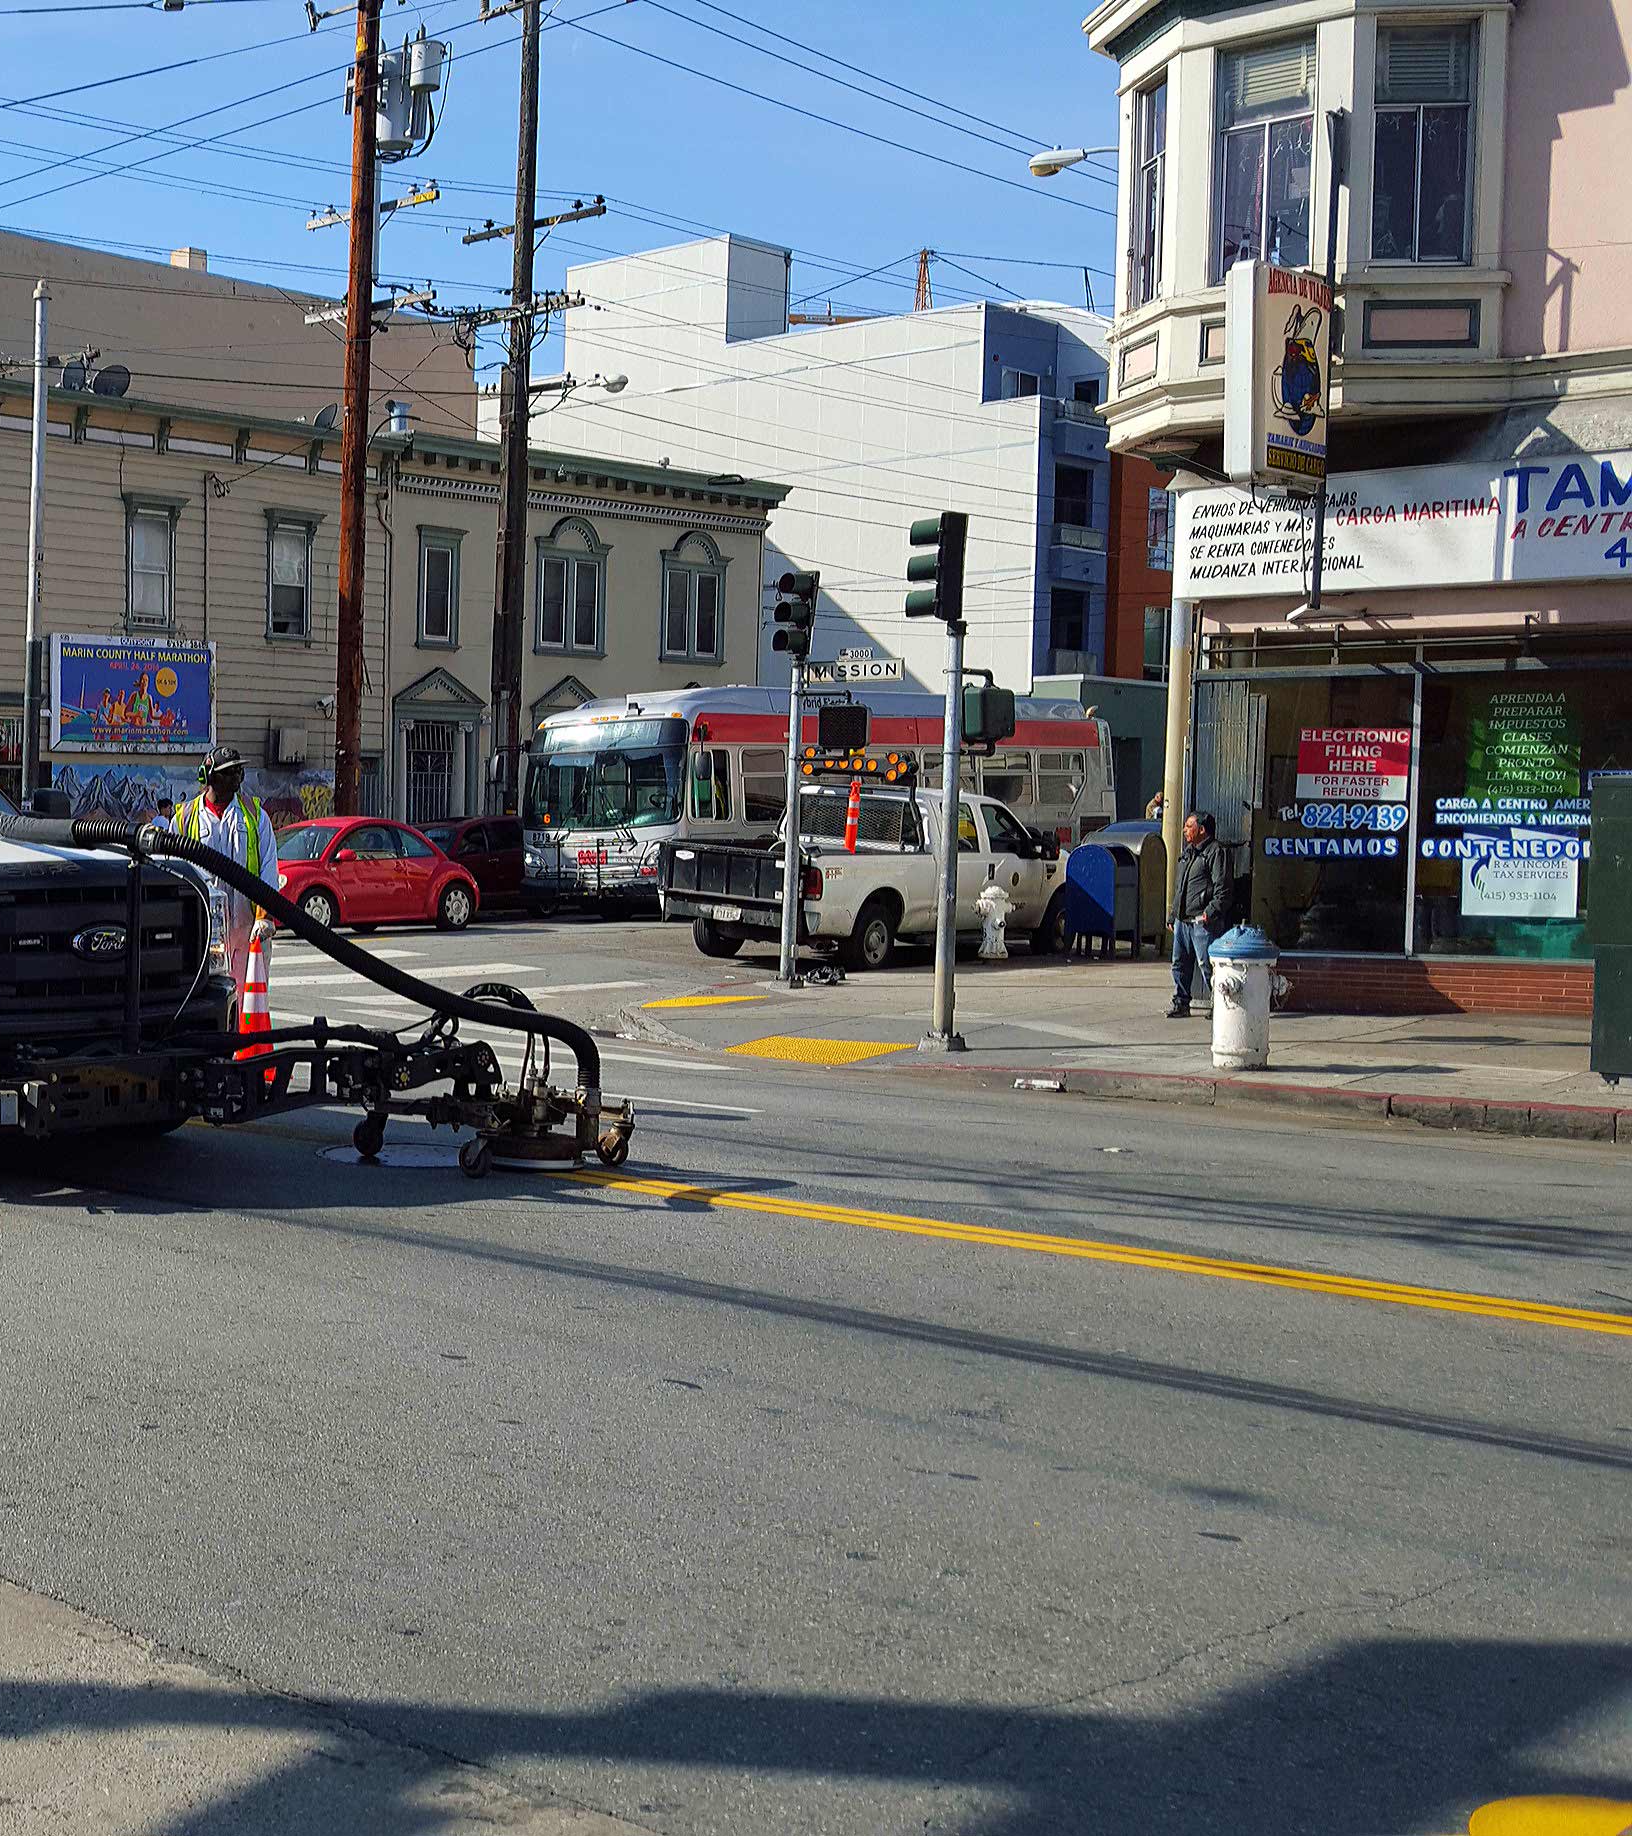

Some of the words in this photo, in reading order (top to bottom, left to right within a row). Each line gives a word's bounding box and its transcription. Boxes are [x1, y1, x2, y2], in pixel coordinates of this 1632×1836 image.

[1268, 267, 1298, 295] AGENCIA
[1298, 277, 1308, 299] DE
[1192, 501, 1236, 520] ENVIOS
[1238, 500, 1255, 516] DE
[1336, 504, 1397, 527] CARGA
[1403, 496, 1503, 522] MARITIMA
[1189, 520, 1271, 541] MAQUINARIAS
[1274, 521, 1281, 533] Y
[1511, 520, 1528, 540] A
[1189, 545, 1204, 560] SE
[1207, 543, 1245, 559] RENTA
[1189, 561, 1257, 580] MUDANZA
[62, 647, 94, 658] MARIN
[96, 649, 132, 660] COUNTY
[134, 650, 156, 661] HALF
[157, 651, 207, 664] MARATHON
[849, 648, 870, 659] 3000
[815, 662, 898, 678] MISSION
[1489, 693, 1554, 704] APRENDA
[1556, 693, 1566, 703] A
[1493, 705, 1563, 717] PREPARAR
[1488, 718, 1567, 730] IMPUESTOS
[1301, 729, 1409, 744] ELECTRONIC
[1502, 731, 1552, 742] CLASES
[1325, 745, 1382, 757] FILING
[1485, 744, 1568, 756] COMIENZAN
[1329, 760, 1377, 772] HERE
[1498, 757, 1555, 768] PRONTO
[1314, 776, 1339, 785] FOR
[1342, 777, 1390, 786] FASTER
[1487, 770, 1532, 781] LLAME
[1535, 770, 1567, 781] HOY!
[1322, 787, 1380, 797] REFUNDS
[1487, 784, 1514, 795] (415)
[1516, 784, 1564, 794] 933-1104
[1436, 798, 1478, 810] CARGA
[1481, 798, 1491, 810] A
[1498, 798, 1548, 810] CENTRO
[543, 813, 551, 824] 6
[1278, 803, 1302, 822] Tel.
[1301, 803, 1409, 831] 824-9439
[1436, 813, 1522, 825] ENCOMIENDAS
[1527, 813, 1537, 825] A
[532, 832, 551, 841] 8719
[1264, 838, 1397, 855] RENTAMOS
[1493, 861, 1501, 869] R
[1502, 861, 1510, 869] &
[1511, 861, 1520, 869] V
[1521, 861, 1568, 869] INCOME
[1493, 871, 1515, 879] TAX
[1517, 871, 1569, 879] SERVICES
[1480, 891, 1506, 901] (415)
[1509, 891, 1558, 901] 933-1104
[91, 931, 125, 951] Ford
